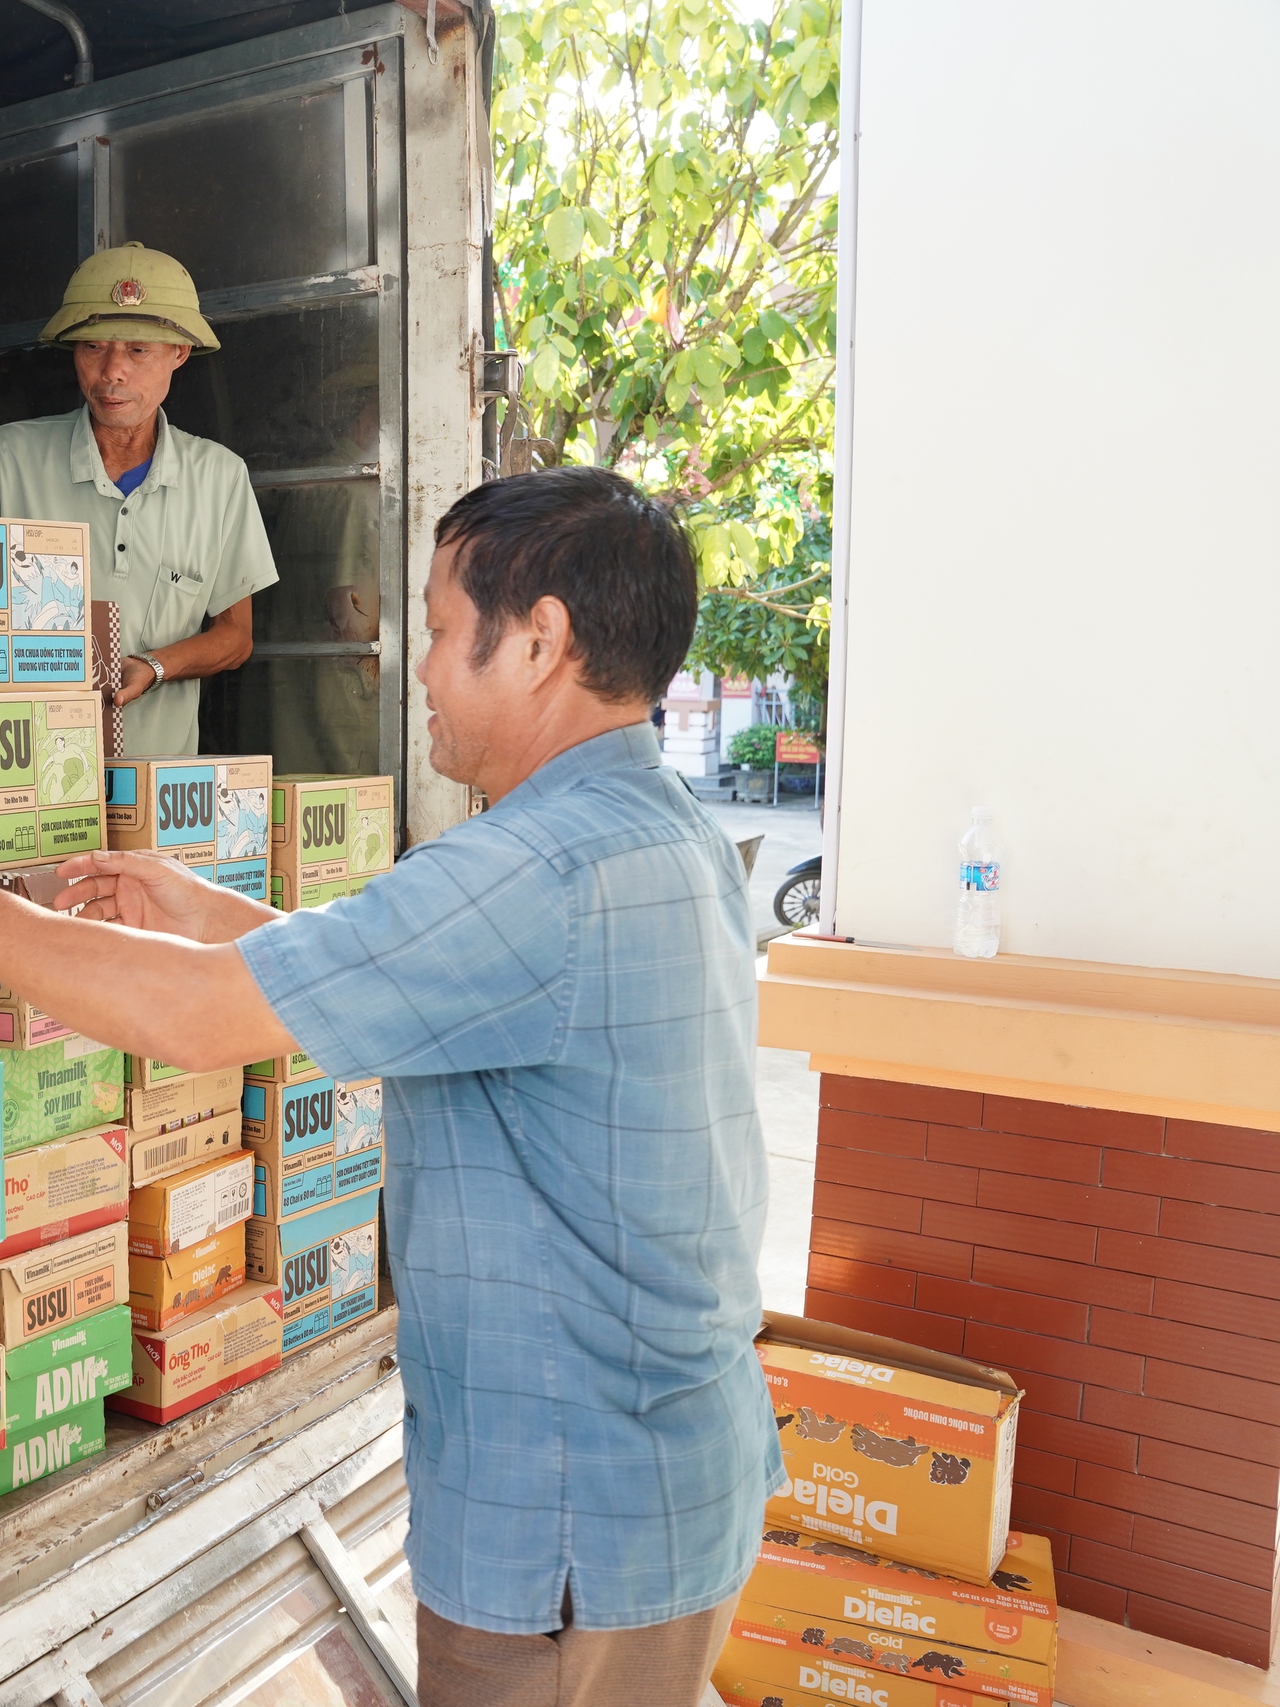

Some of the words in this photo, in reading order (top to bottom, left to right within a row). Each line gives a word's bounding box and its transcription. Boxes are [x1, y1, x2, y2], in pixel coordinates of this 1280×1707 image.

[159, 782, 213, 830] SUSU
[303, 803, 345, 849] SUSU
[6, 839, 13, 849] ml
[302, 871, 318, 879] Vinamilk
[38, 1060, 87, 1090] Vinamilk
[44, 1097, 60, 1116] SOY
[62, 1091, 81, 1111] MILK
[284, 1089, 333, 1142] SUSU
[110, 1138, 122, 1153] MỚI
[284, 1160, 302, 1171] Vinamilk
[27, 1265, 49, 1279] Vinamilk
[193, 1264, 216, 1284] Dielac
[284, 1244, 328, 1302] SUSU
[27, 1289, 68, 1330] SUSU
[284, 1307, 300, 1319] Vinamilk
[52, 1332, 86, 1351] Vinamilk
[169, 1350, 190, 1370] Ông
[191, 1342, 210, 1359] Thọ
[809, 1353, 894, 1382] Dielac
[36, 1356, 95, 1419] ADM
[825, 1370, 866, 1385] Vinamilk
[13, 1423, 70, 1488] ADM
[813, 1462, 859, 1487] Gold
[801, 1514, 862, 1543] Vinamilk
[868, 1588, 914, 1606] Vinamilk
[844, 1595, 936, 1634] Dielac
[868, 1632, 903, 1649] Gold
[822, 1660, 866, 1679] Vinamilk
[799, 1666, 888, 1707] Dielac
